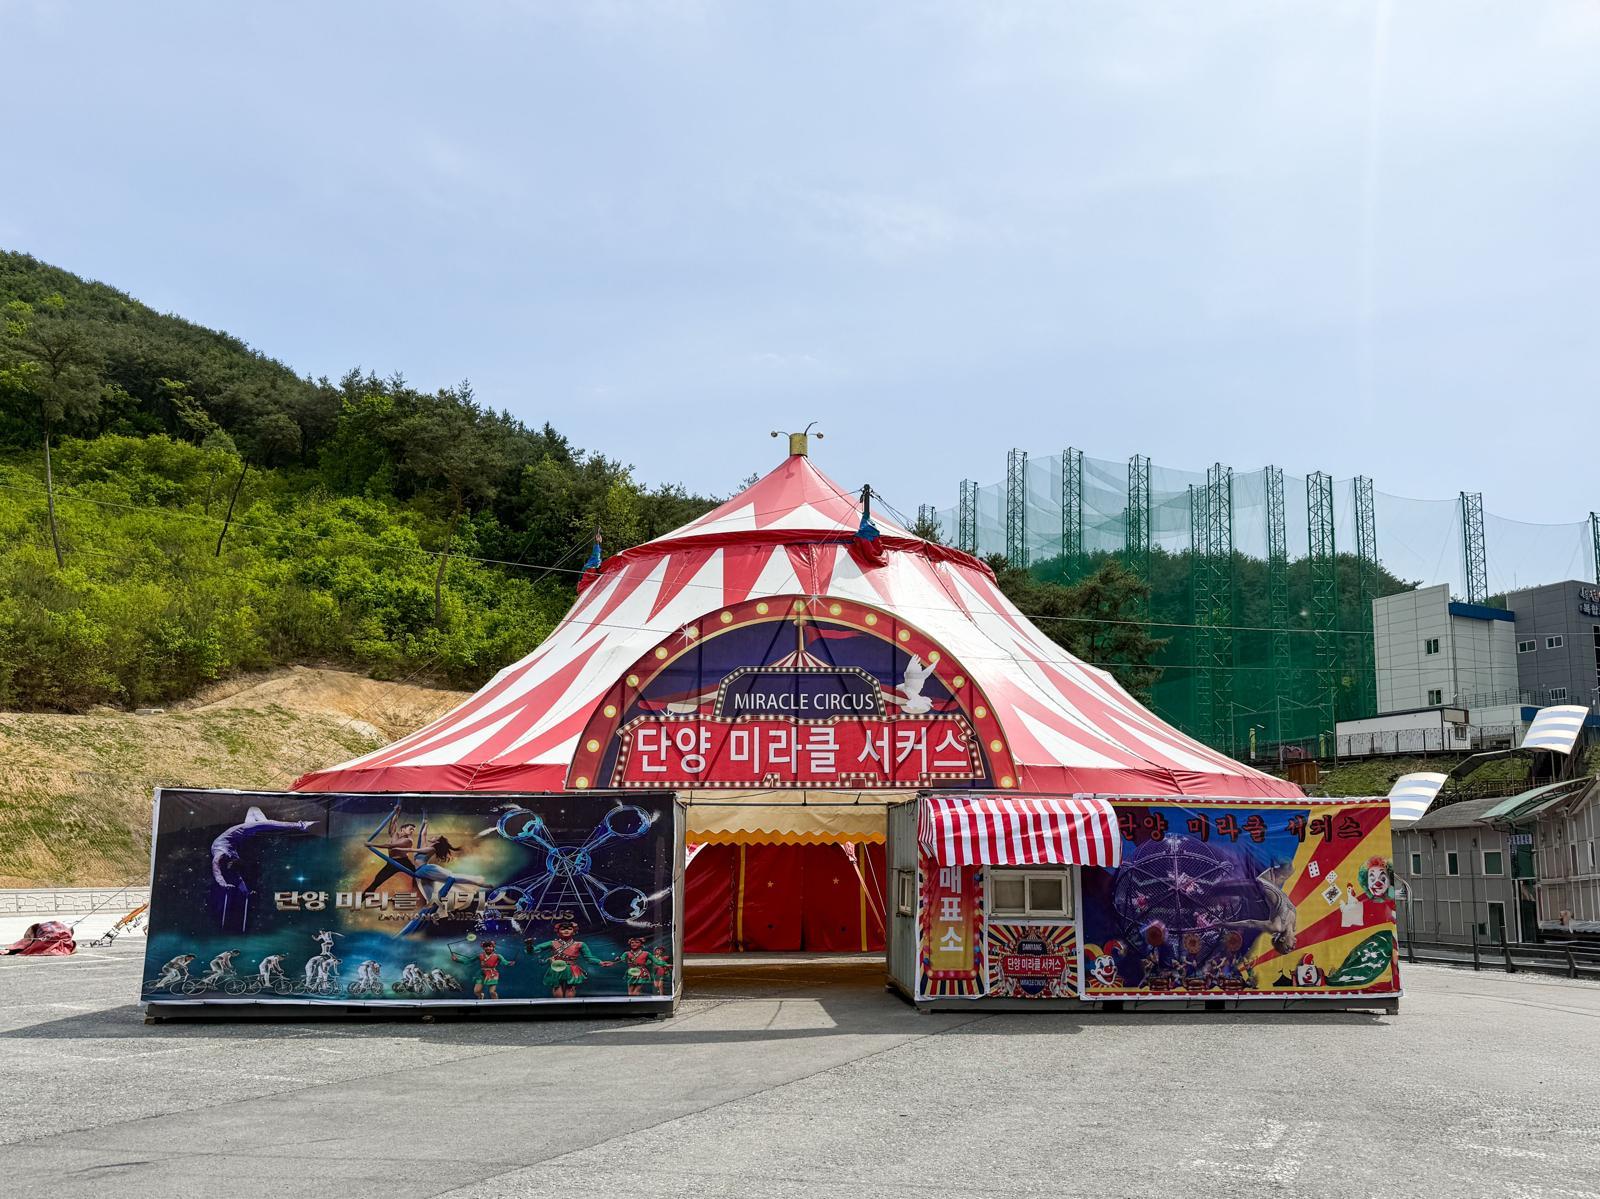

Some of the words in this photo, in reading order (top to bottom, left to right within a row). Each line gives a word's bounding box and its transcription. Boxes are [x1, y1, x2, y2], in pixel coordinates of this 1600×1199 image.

[734, 693, 809, 710] MIRACLE
[813, 693, 875, 710] CIRCUS
[637, 726, 712, 774] 단양
[730, 726, 840, 774] 미라클
[857, 726, 968, 774] 서커스
[1118, 812, 1168, 842] 단양
[1187, 813, 1268, 843] 미라클
[1286, 814, 1363, 843] 서커스
[274, 890, 329, 912] 단양
[335, 890, 420, 912] 미라클
[939, 865, 964, 952] 매표소
[1007, 958, 1021, 971] 단양
[1021, 958, 1040, 971] 미라클
[1042, 958, 1061, 971] 서커스
